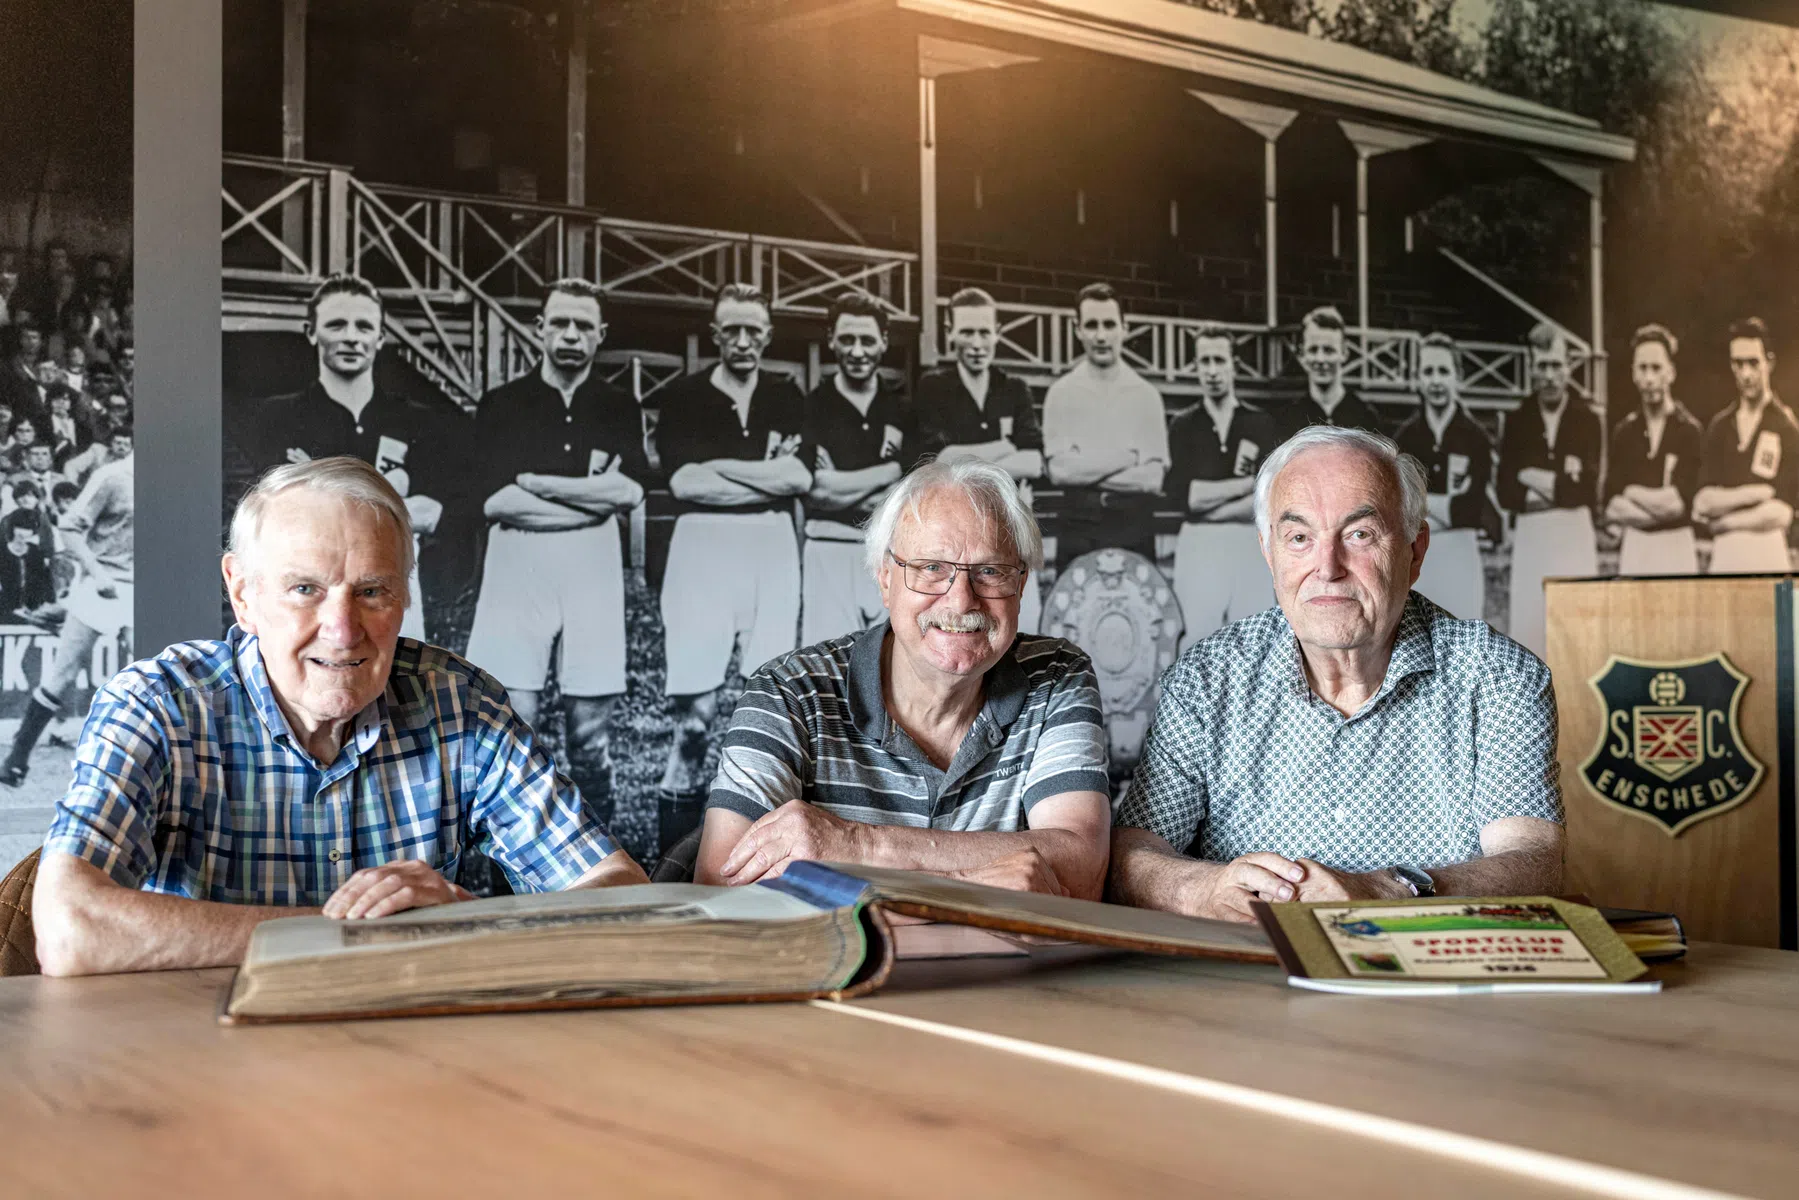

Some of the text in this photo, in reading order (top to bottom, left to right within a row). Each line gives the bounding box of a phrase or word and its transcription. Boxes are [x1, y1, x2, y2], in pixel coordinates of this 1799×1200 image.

[1595, 768, 1746, 811] ENSCHEDE
[1412, 936, 1564, 947] SPORTCLUB
[1428, 946, 1564, 956] ENSCHEDE
